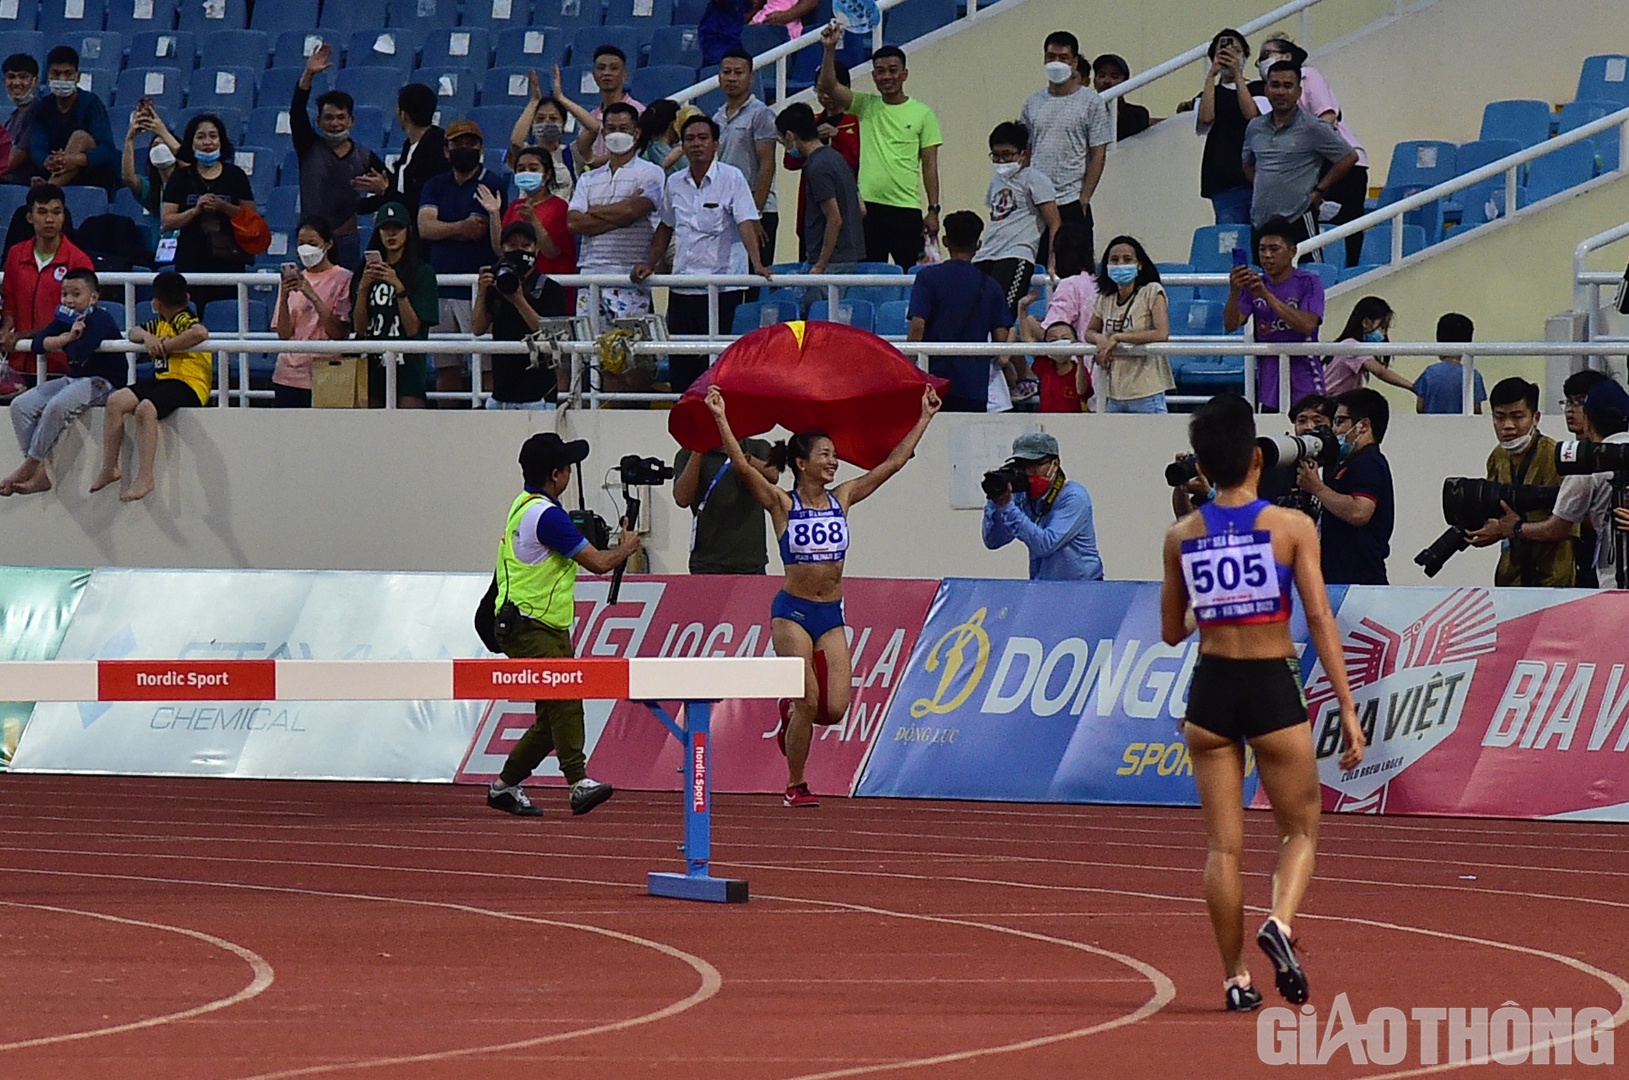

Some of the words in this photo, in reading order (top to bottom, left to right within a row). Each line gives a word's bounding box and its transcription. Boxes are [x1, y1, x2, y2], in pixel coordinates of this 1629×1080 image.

[794, 521, 843, 546] 868
[1191, 553, 1267, 594] 505
[187, 671, 229, 689] Sport
[542, 669, 584, 687] Sport
[1383, 670, 1466, 742] VIỆT
[1481, 659, 1597, 751] BIA
[150, 706, 306, 732] CHEMICAL
[1360, 762, 1381, 778] BREW
